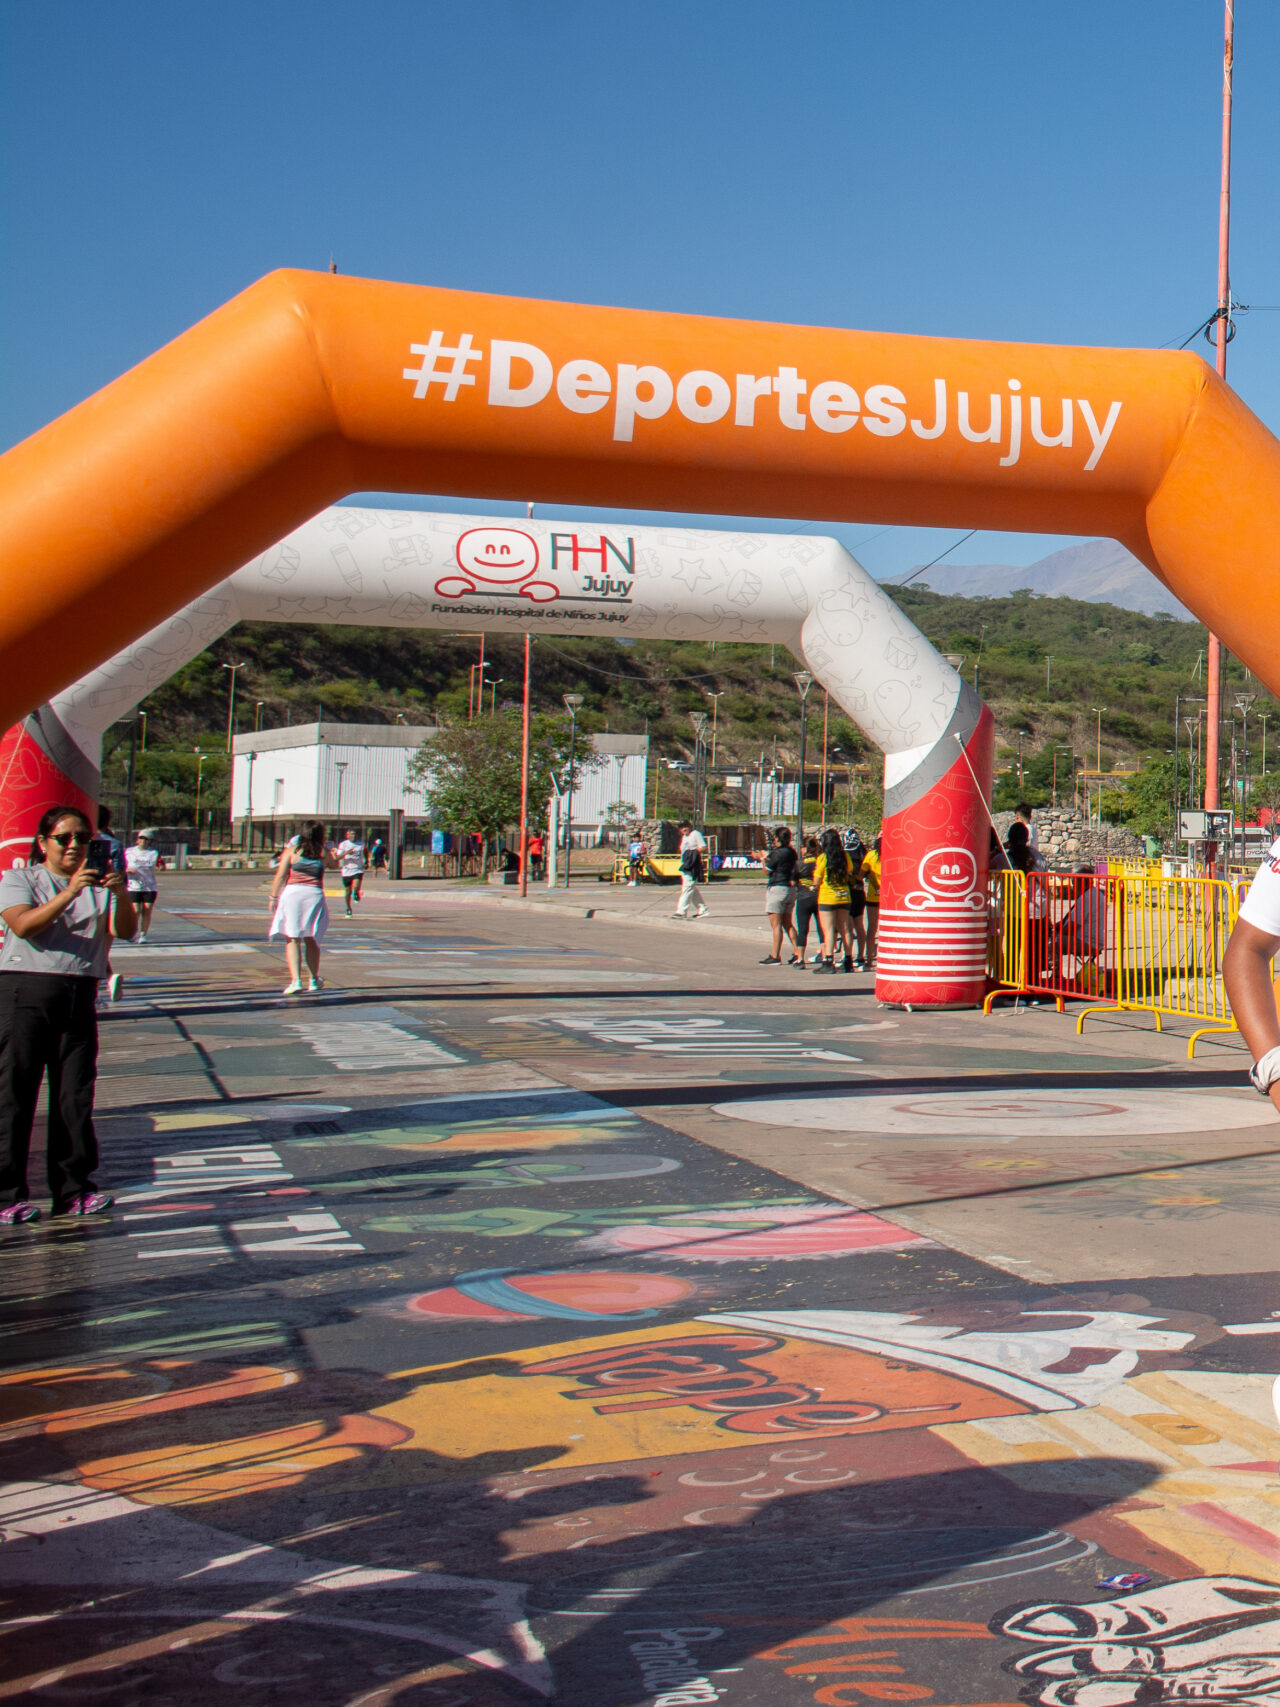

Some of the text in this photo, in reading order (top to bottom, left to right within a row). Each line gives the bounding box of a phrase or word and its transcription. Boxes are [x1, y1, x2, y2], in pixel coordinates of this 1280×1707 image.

[402, 330, 1123, 471] #DeportesJujuy
[550, 533, 635, 574] FHN
[582, 574, 634, 597] Jujuy
[431, 604, 630, 623] Fundación Hospital de Niños Jujuy
